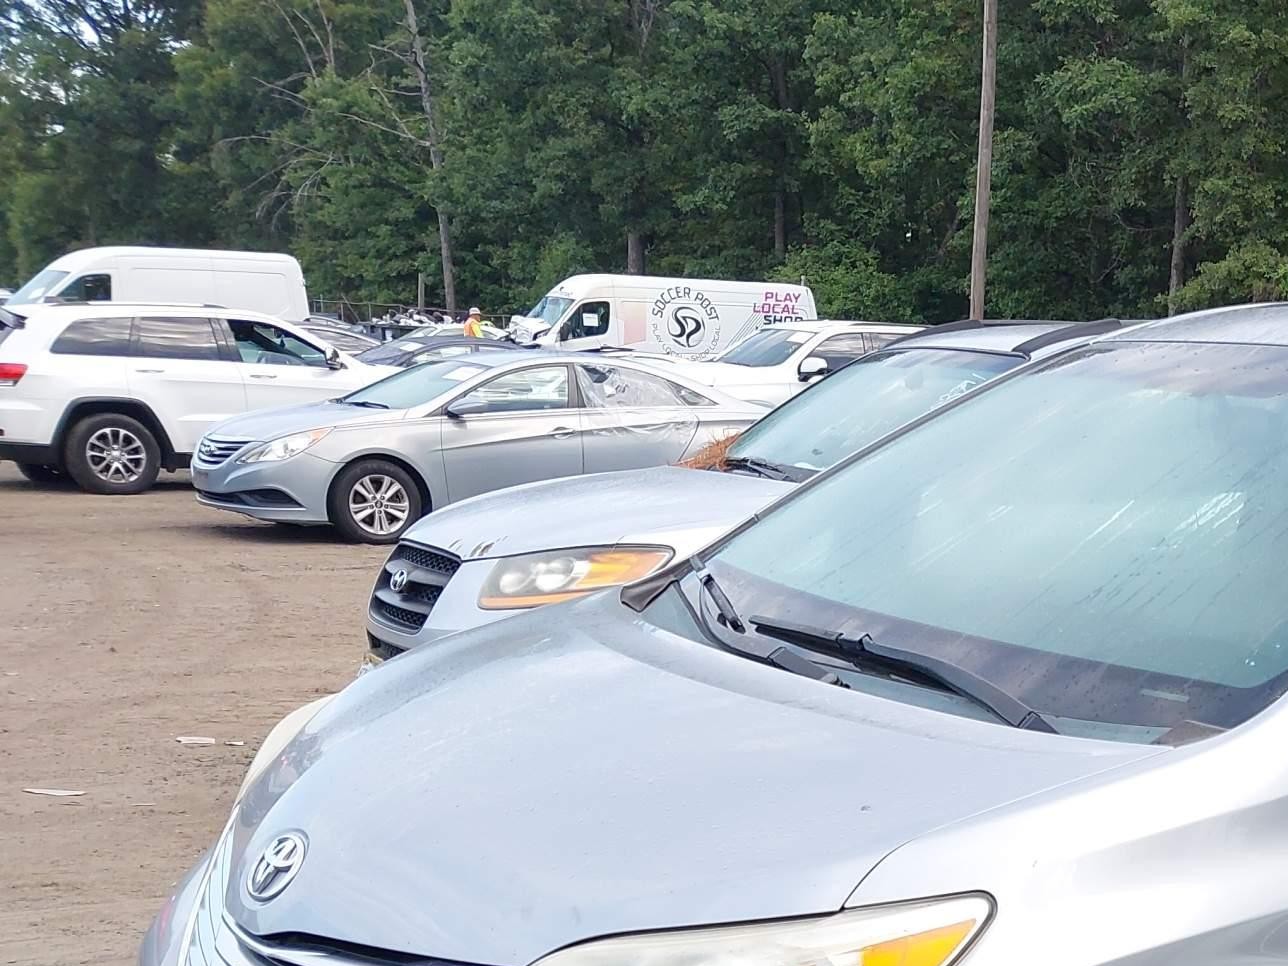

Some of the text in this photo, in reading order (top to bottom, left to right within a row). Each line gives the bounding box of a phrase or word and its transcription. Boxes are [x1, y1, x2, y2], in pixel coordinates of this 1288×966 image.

[652, 286, 720, 320] SOCCER POST
[764, 291, 801, 303] PLAY
[752, 302, 800, 315] LOCAL
